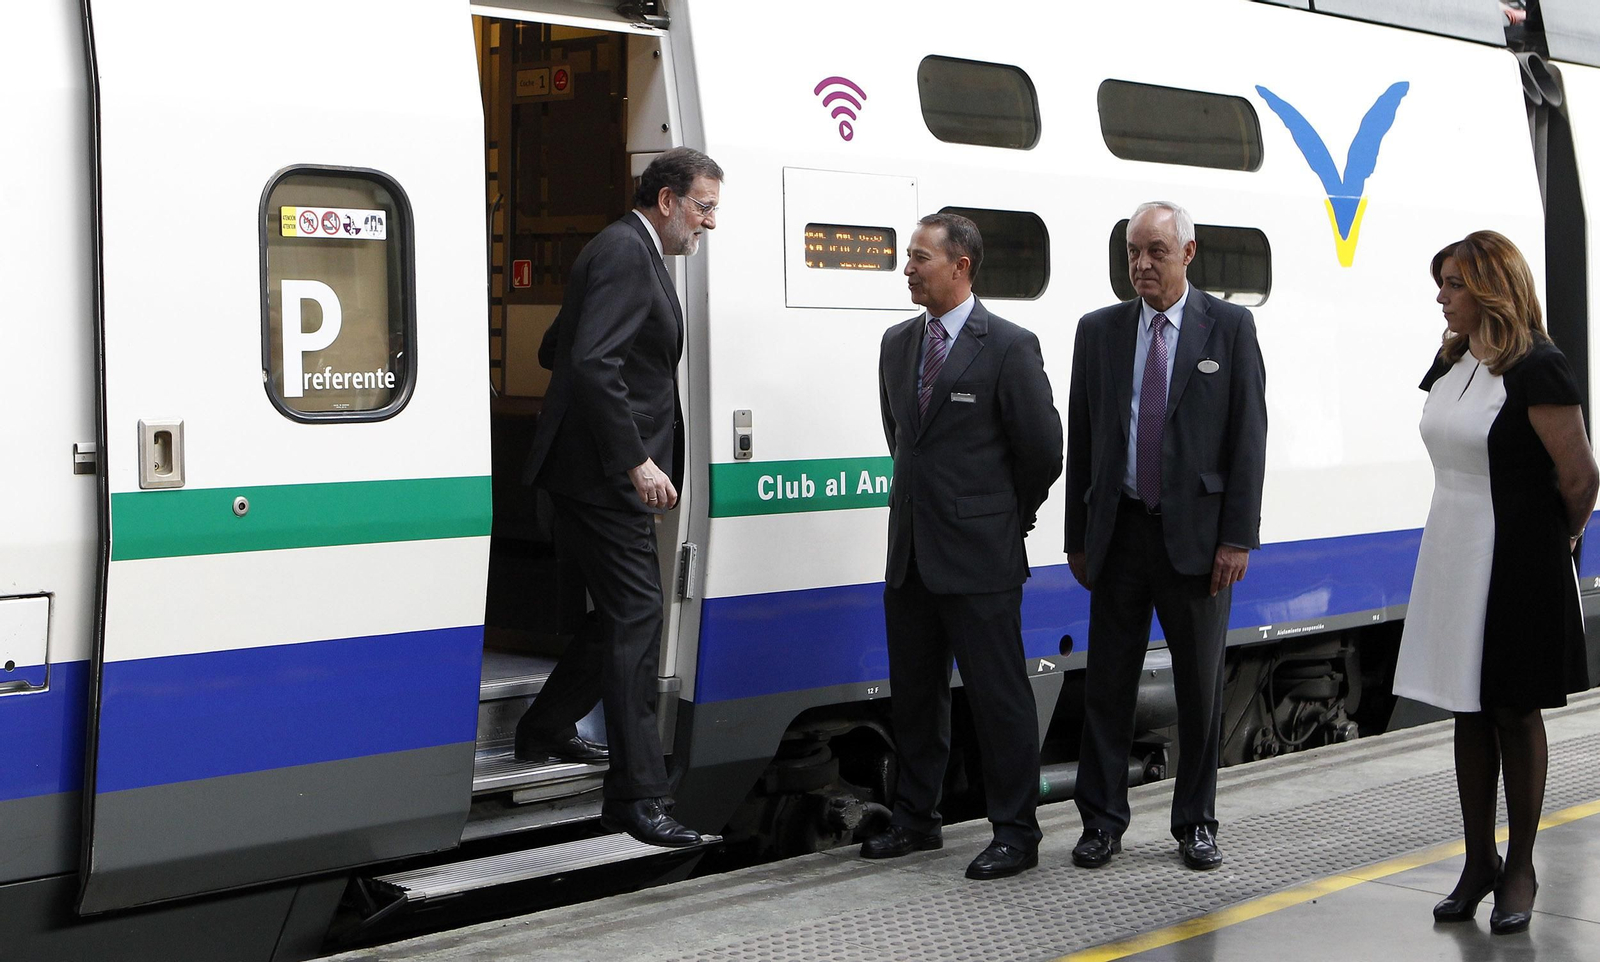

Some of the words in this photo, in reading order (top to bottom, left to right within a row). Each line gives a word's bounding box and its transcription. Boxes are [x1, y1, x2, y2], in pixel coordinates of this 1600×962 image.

[539, 75, 545, 89] 1
[757, 473, 815, 500] Club
[825, 471, 846, 497] al
